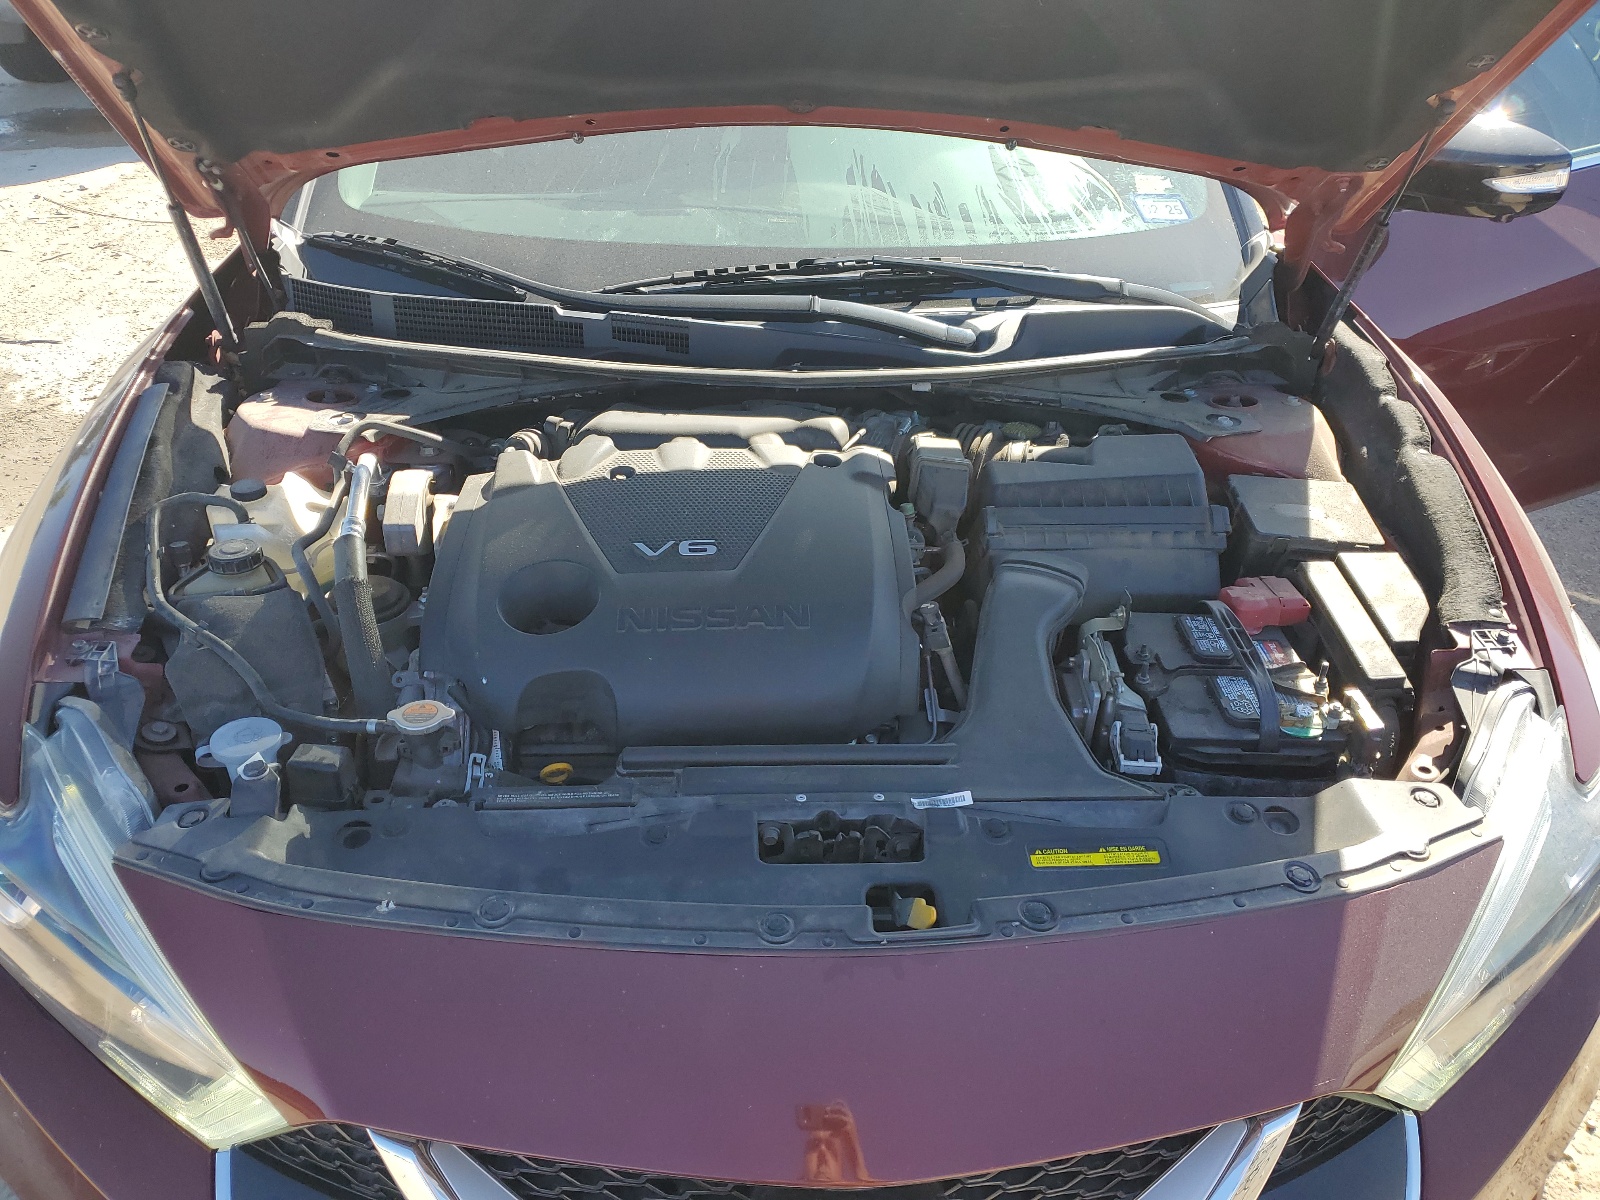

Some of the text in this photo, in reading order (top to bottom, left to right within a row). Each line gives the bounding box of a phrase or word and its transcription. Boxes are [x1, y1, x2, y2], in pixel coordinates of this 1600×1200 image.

[1165, 204, 1183, 215] 25
[633, 539, 718, 557] V6
[616, 603, 811, 633] NISSAN
